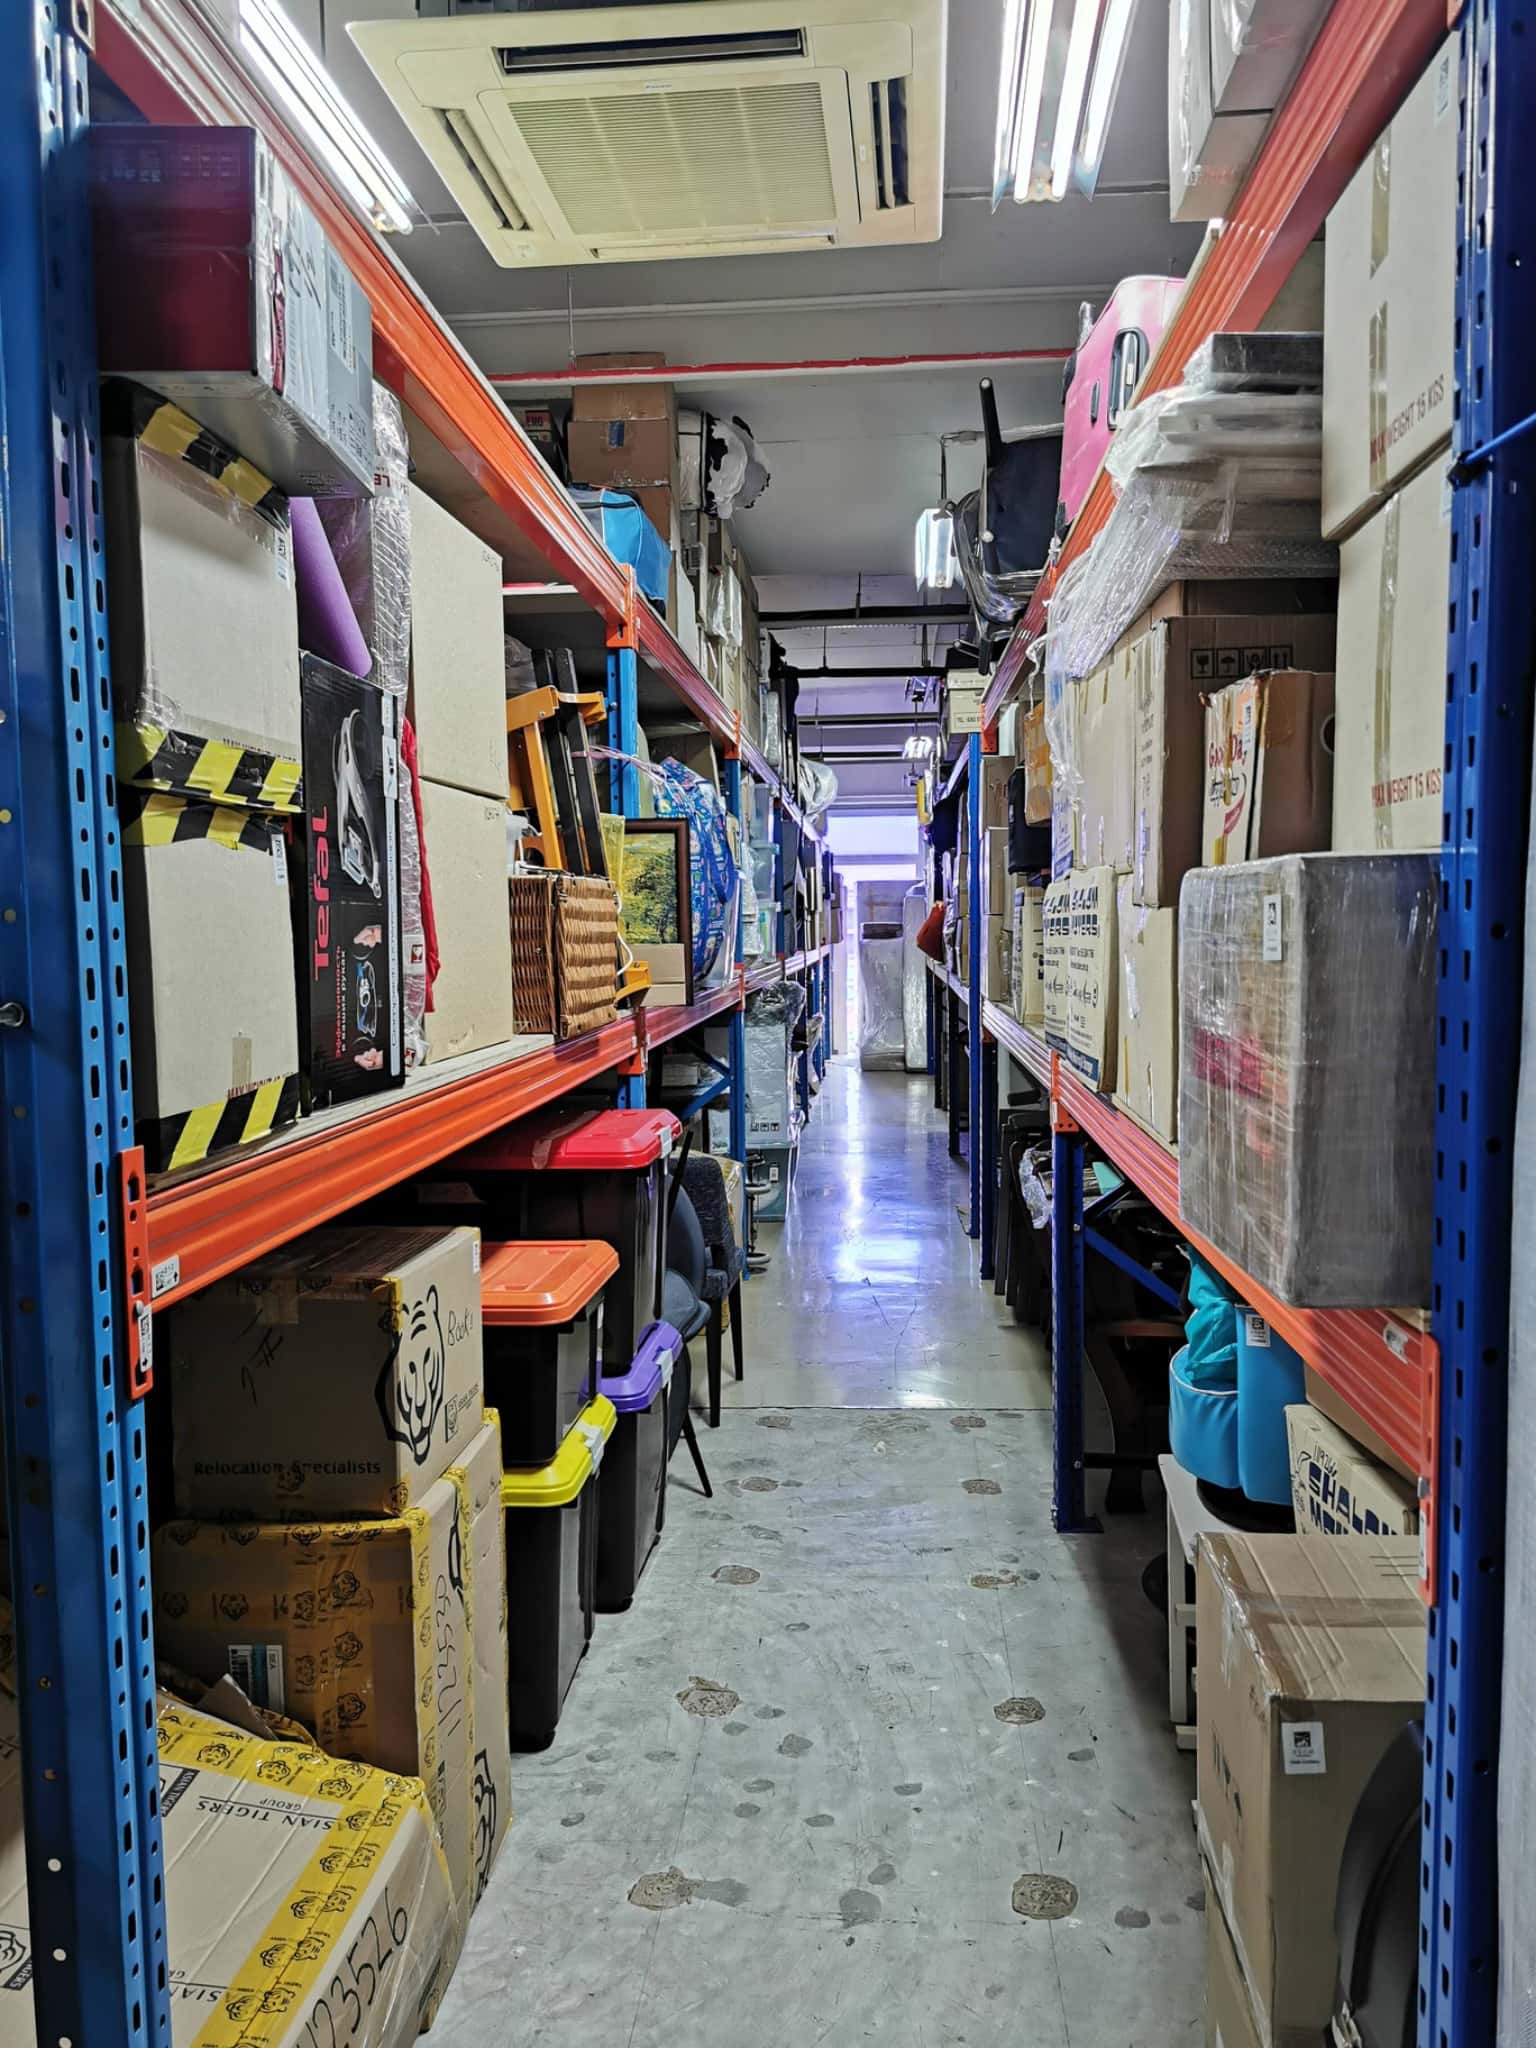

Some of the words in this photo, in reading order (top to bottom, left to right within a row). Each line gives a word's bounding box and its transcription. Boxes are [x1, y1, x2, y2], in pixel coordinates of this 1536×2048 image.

[1415, 772, 1424, 799] 15
[311, 805, 330, 982] Tefal
[194, 1460, 284, 1476] Relocation
[291, 1460, 382, 1477] Specialists
[196, 1799, 270, 1823] TIGERS
[259, 1797, 302, 1811] GROUP
[299, 1887, 408, 2048] 123526
